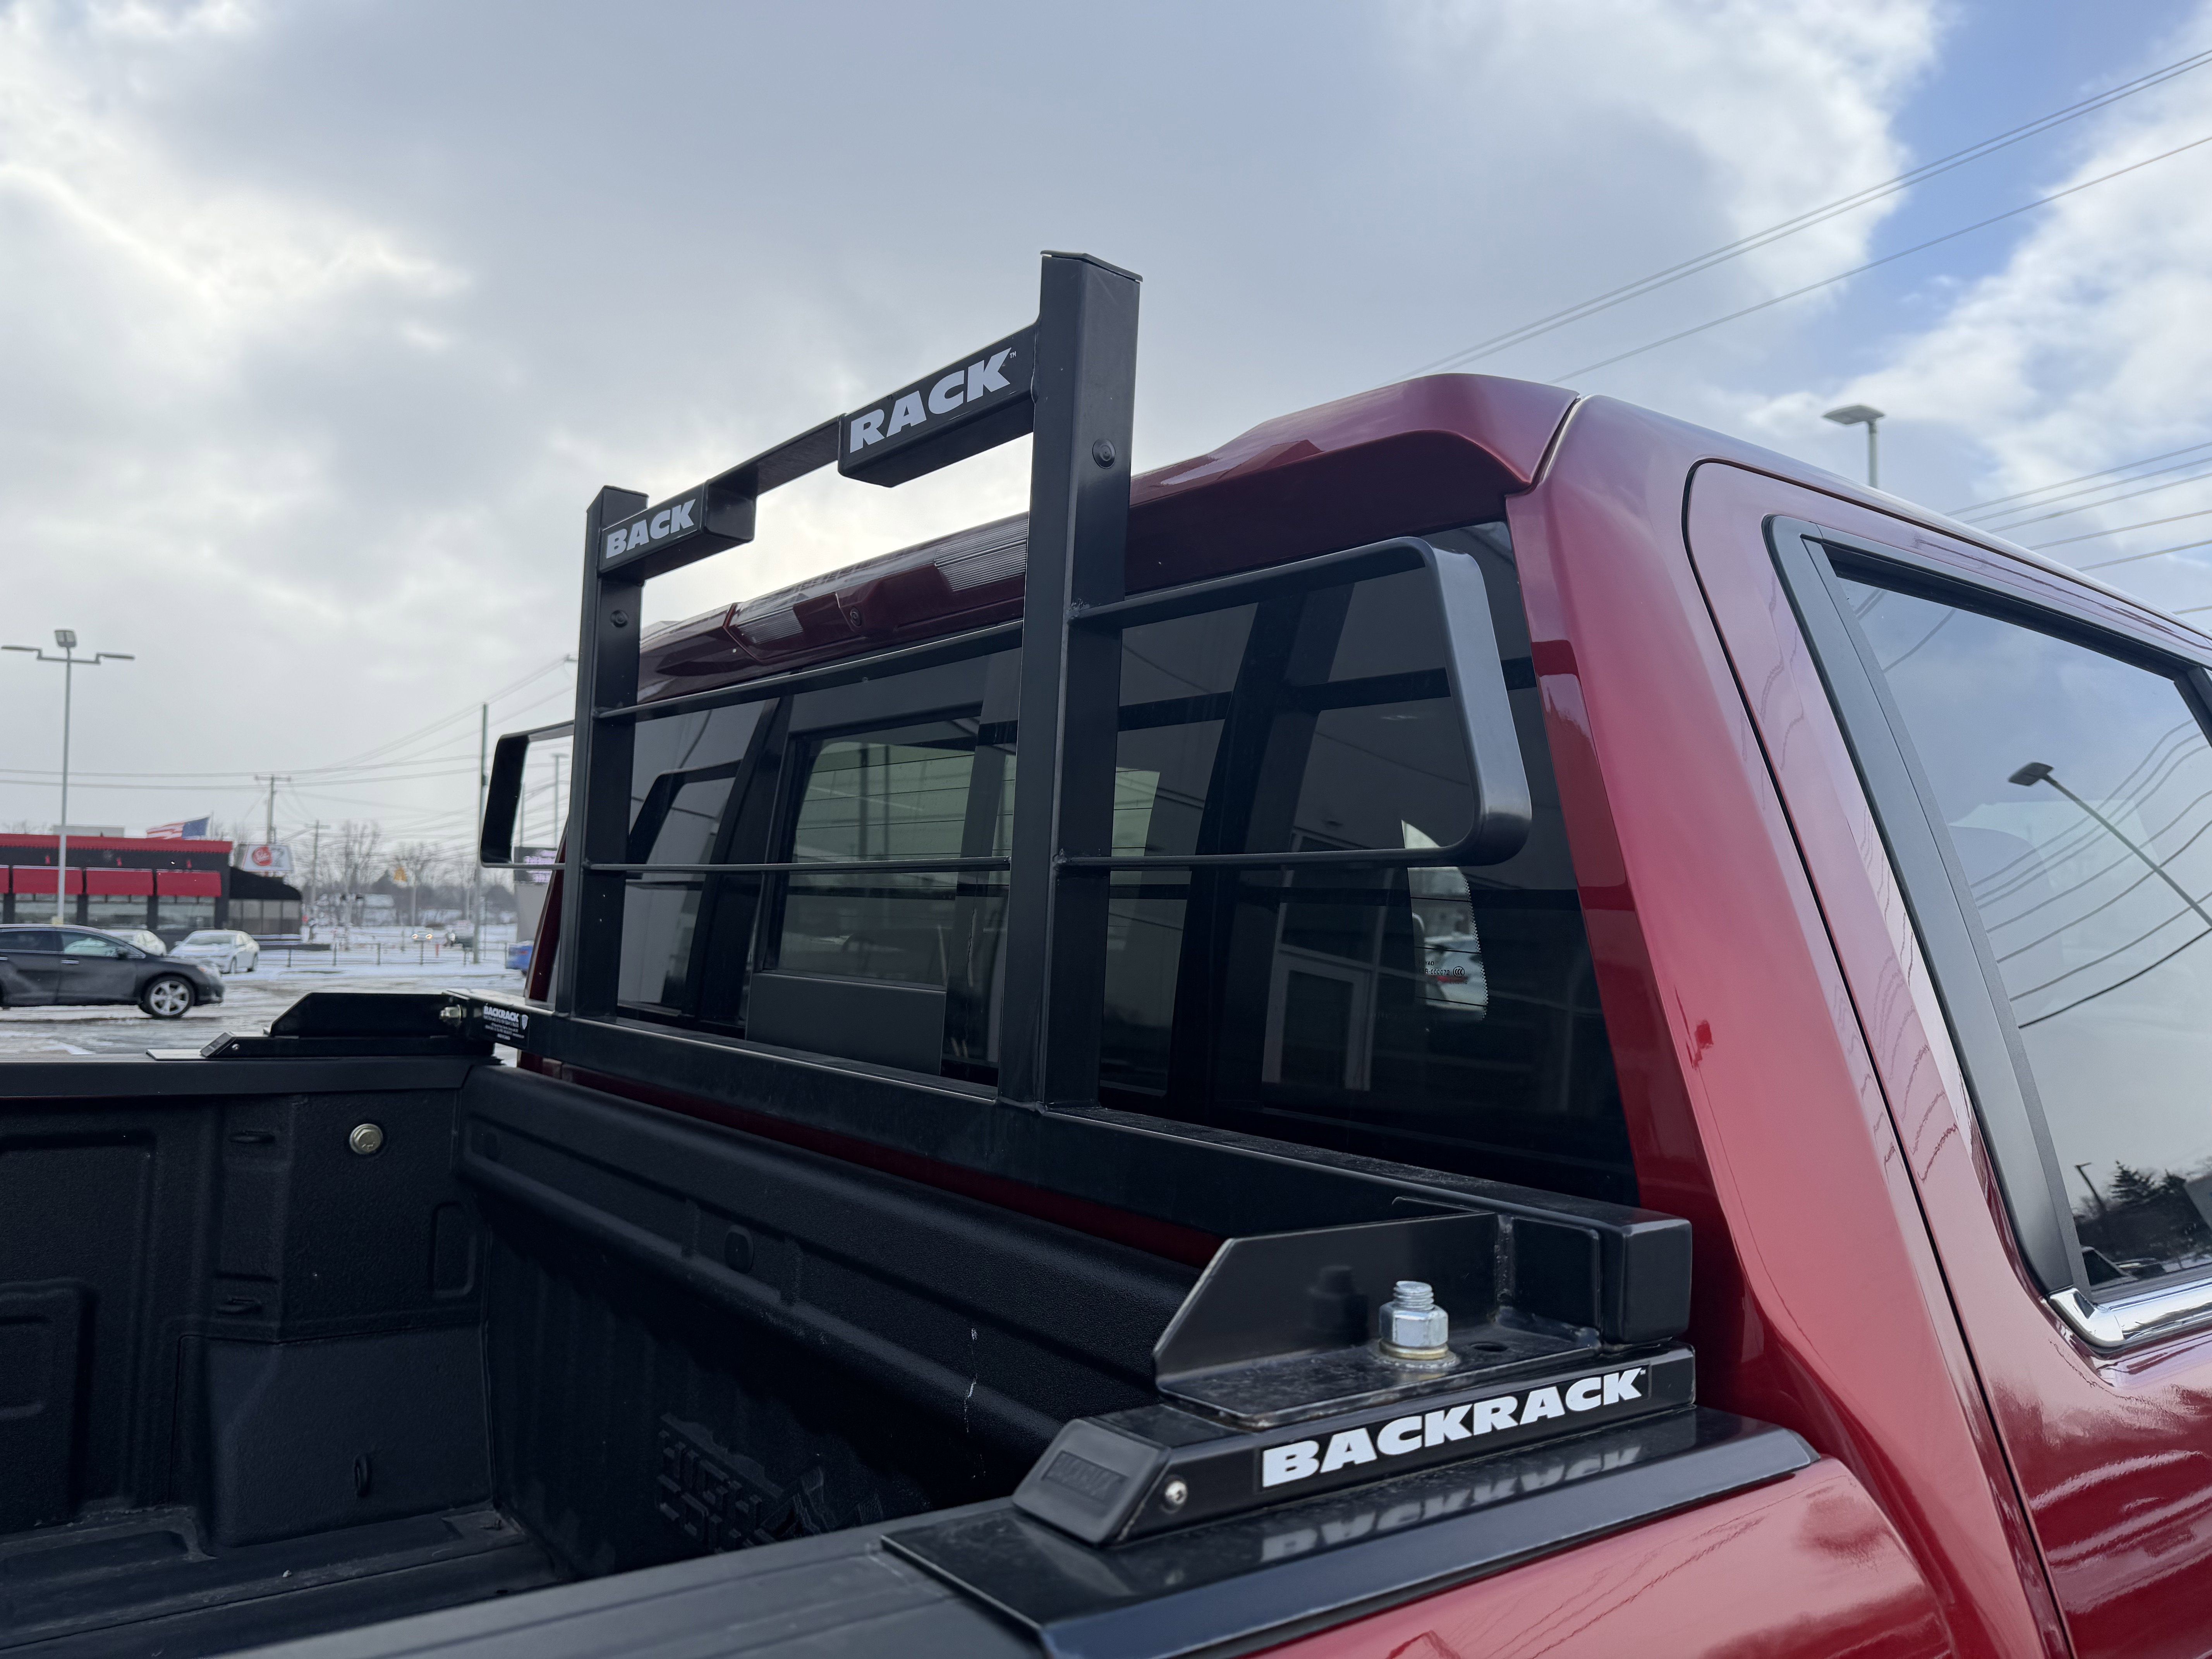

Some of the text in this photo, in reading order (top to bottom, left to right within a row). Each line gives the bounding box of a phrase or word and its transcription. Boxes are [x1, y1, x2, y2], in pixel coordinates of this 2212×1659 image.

[850, 347, 1012, 453] RACK
[606, 499, 696, 559] BACK
[483, 1005, 519, 1023] BACKRACK
[1263, 1367, 1642, 1487] BACKRACK
